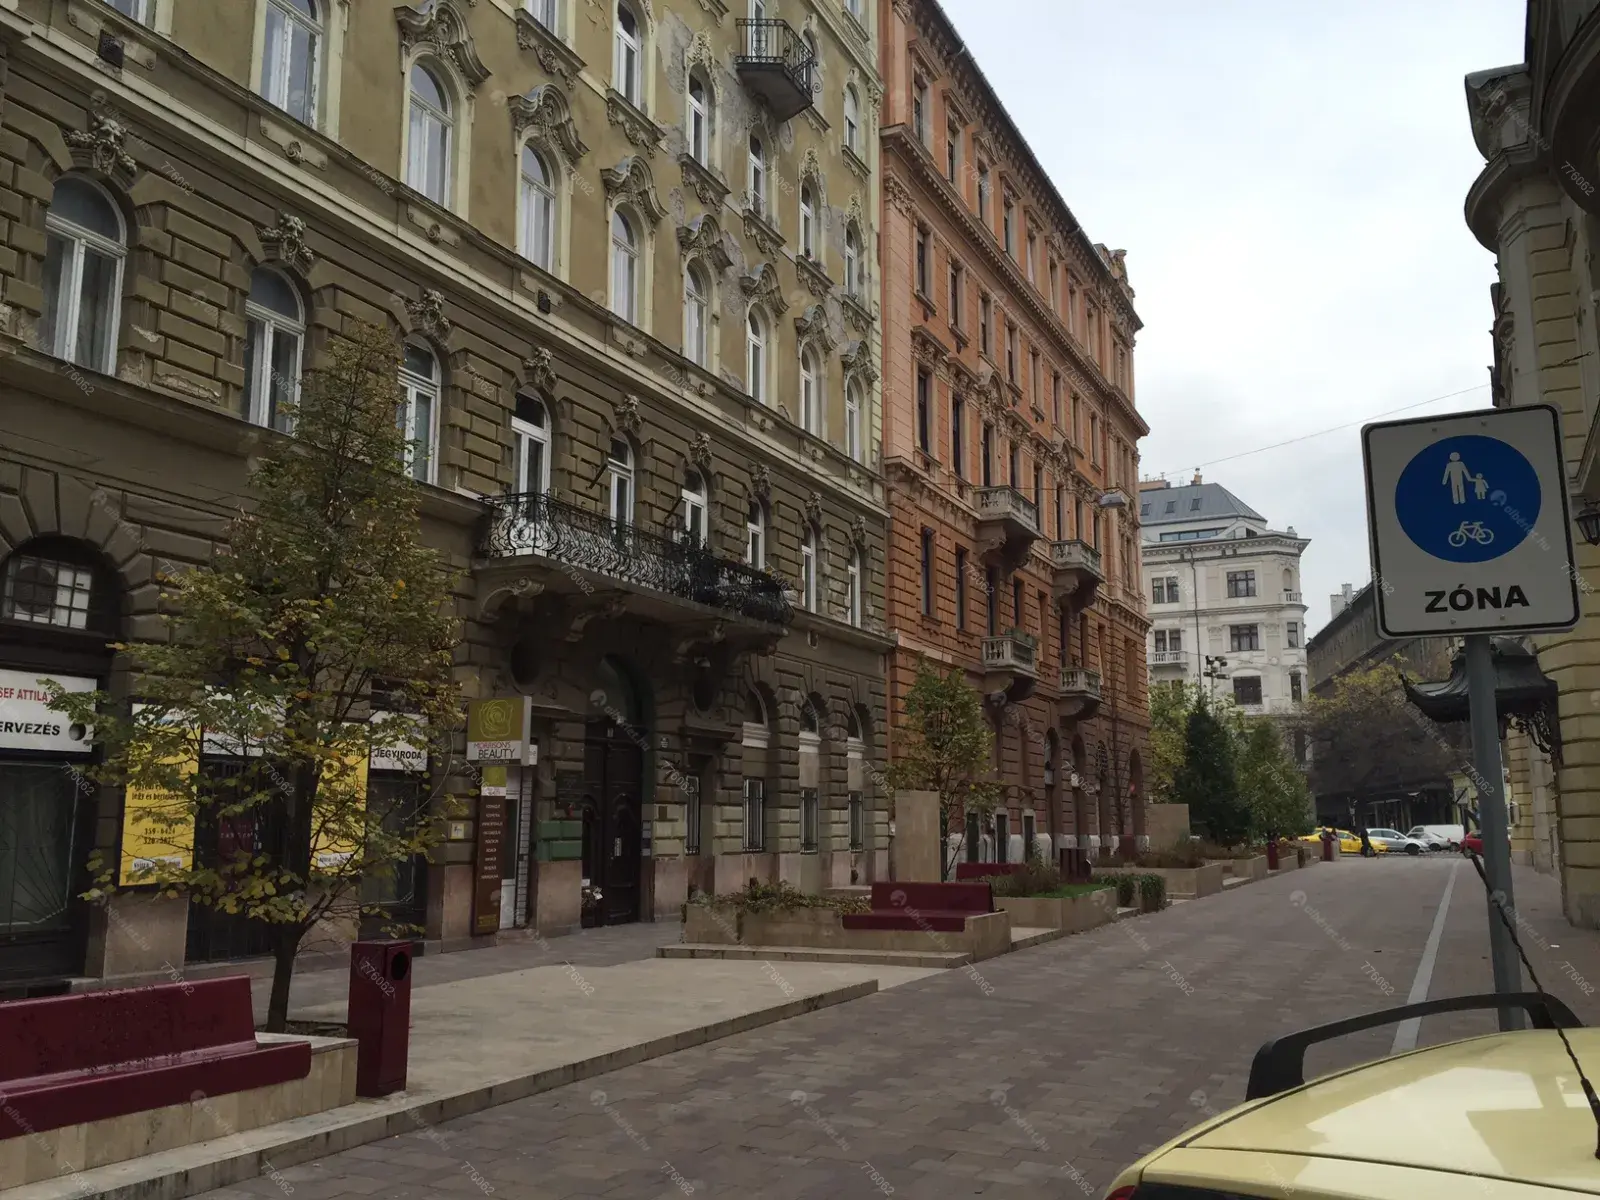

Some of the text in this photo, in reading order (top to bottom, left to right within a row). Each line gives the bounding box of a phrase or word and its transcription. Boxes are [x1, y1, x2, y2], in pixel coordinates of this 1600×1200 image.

[1424, 584, 1530, 614] ZÓNA
[17, 689, 48, 702] ATTILA
[375, 750, 422, 760] JEGYIRODA
[478, 748, 516, 759] BEAUTY
